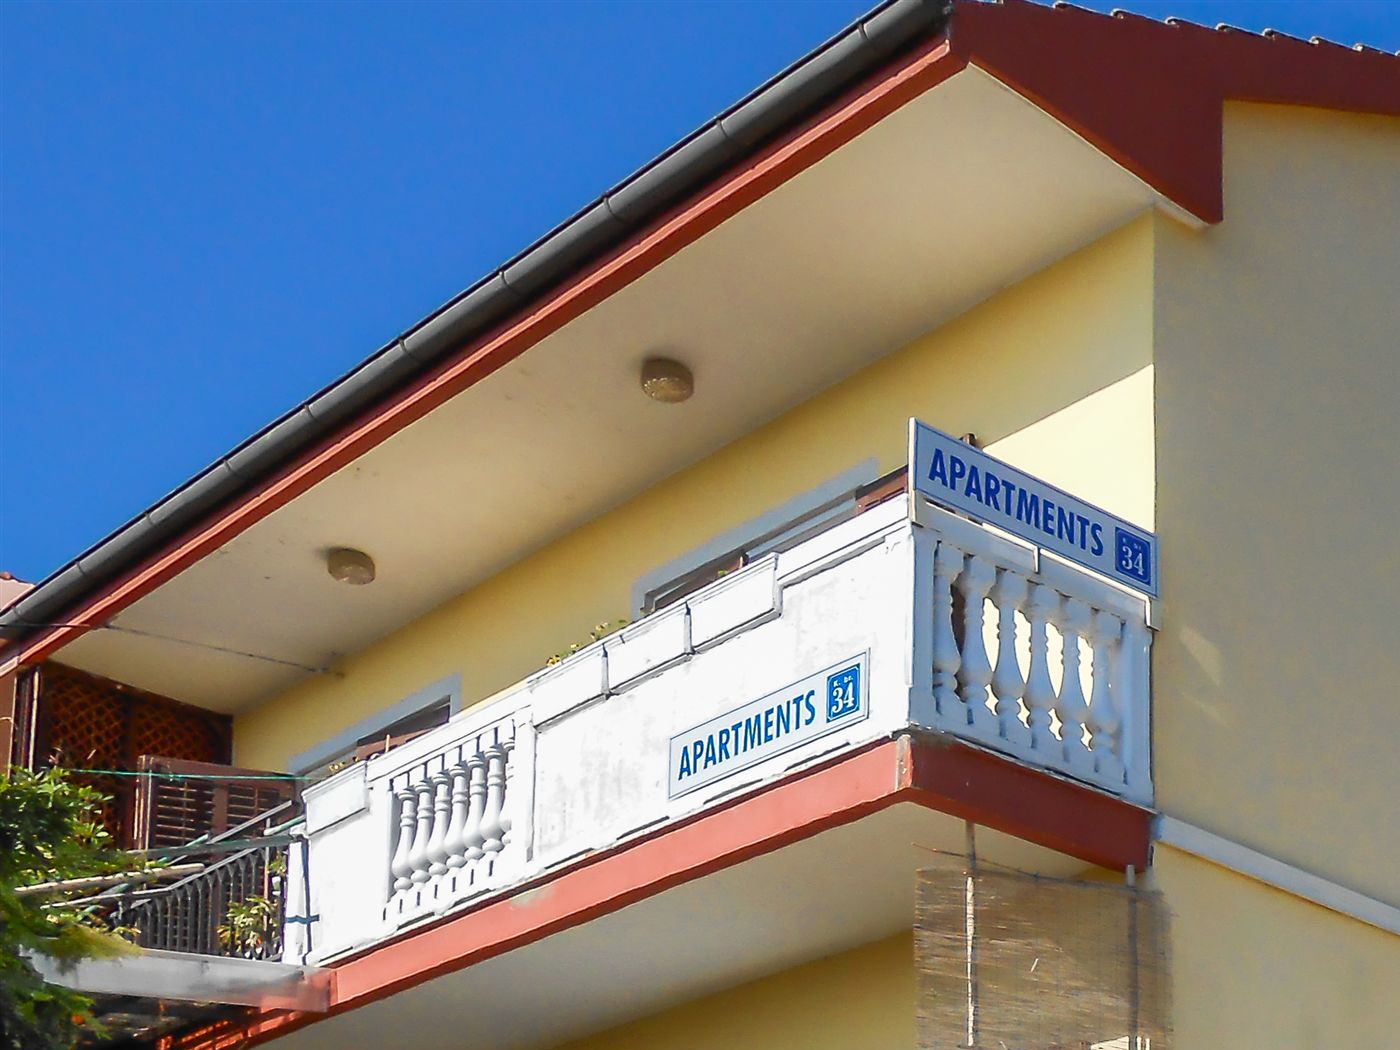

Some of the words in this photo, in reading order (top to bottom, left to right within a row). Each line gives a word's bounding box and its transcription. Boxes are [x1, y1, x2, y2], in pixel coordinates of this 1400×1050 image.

[928, 447, 1104, 557] APARTMENTS
[1121, 545, 1144, 576] 34
[831, 681, 855, 714] 34
[678, 689, 816, 782] APARTMENTS
